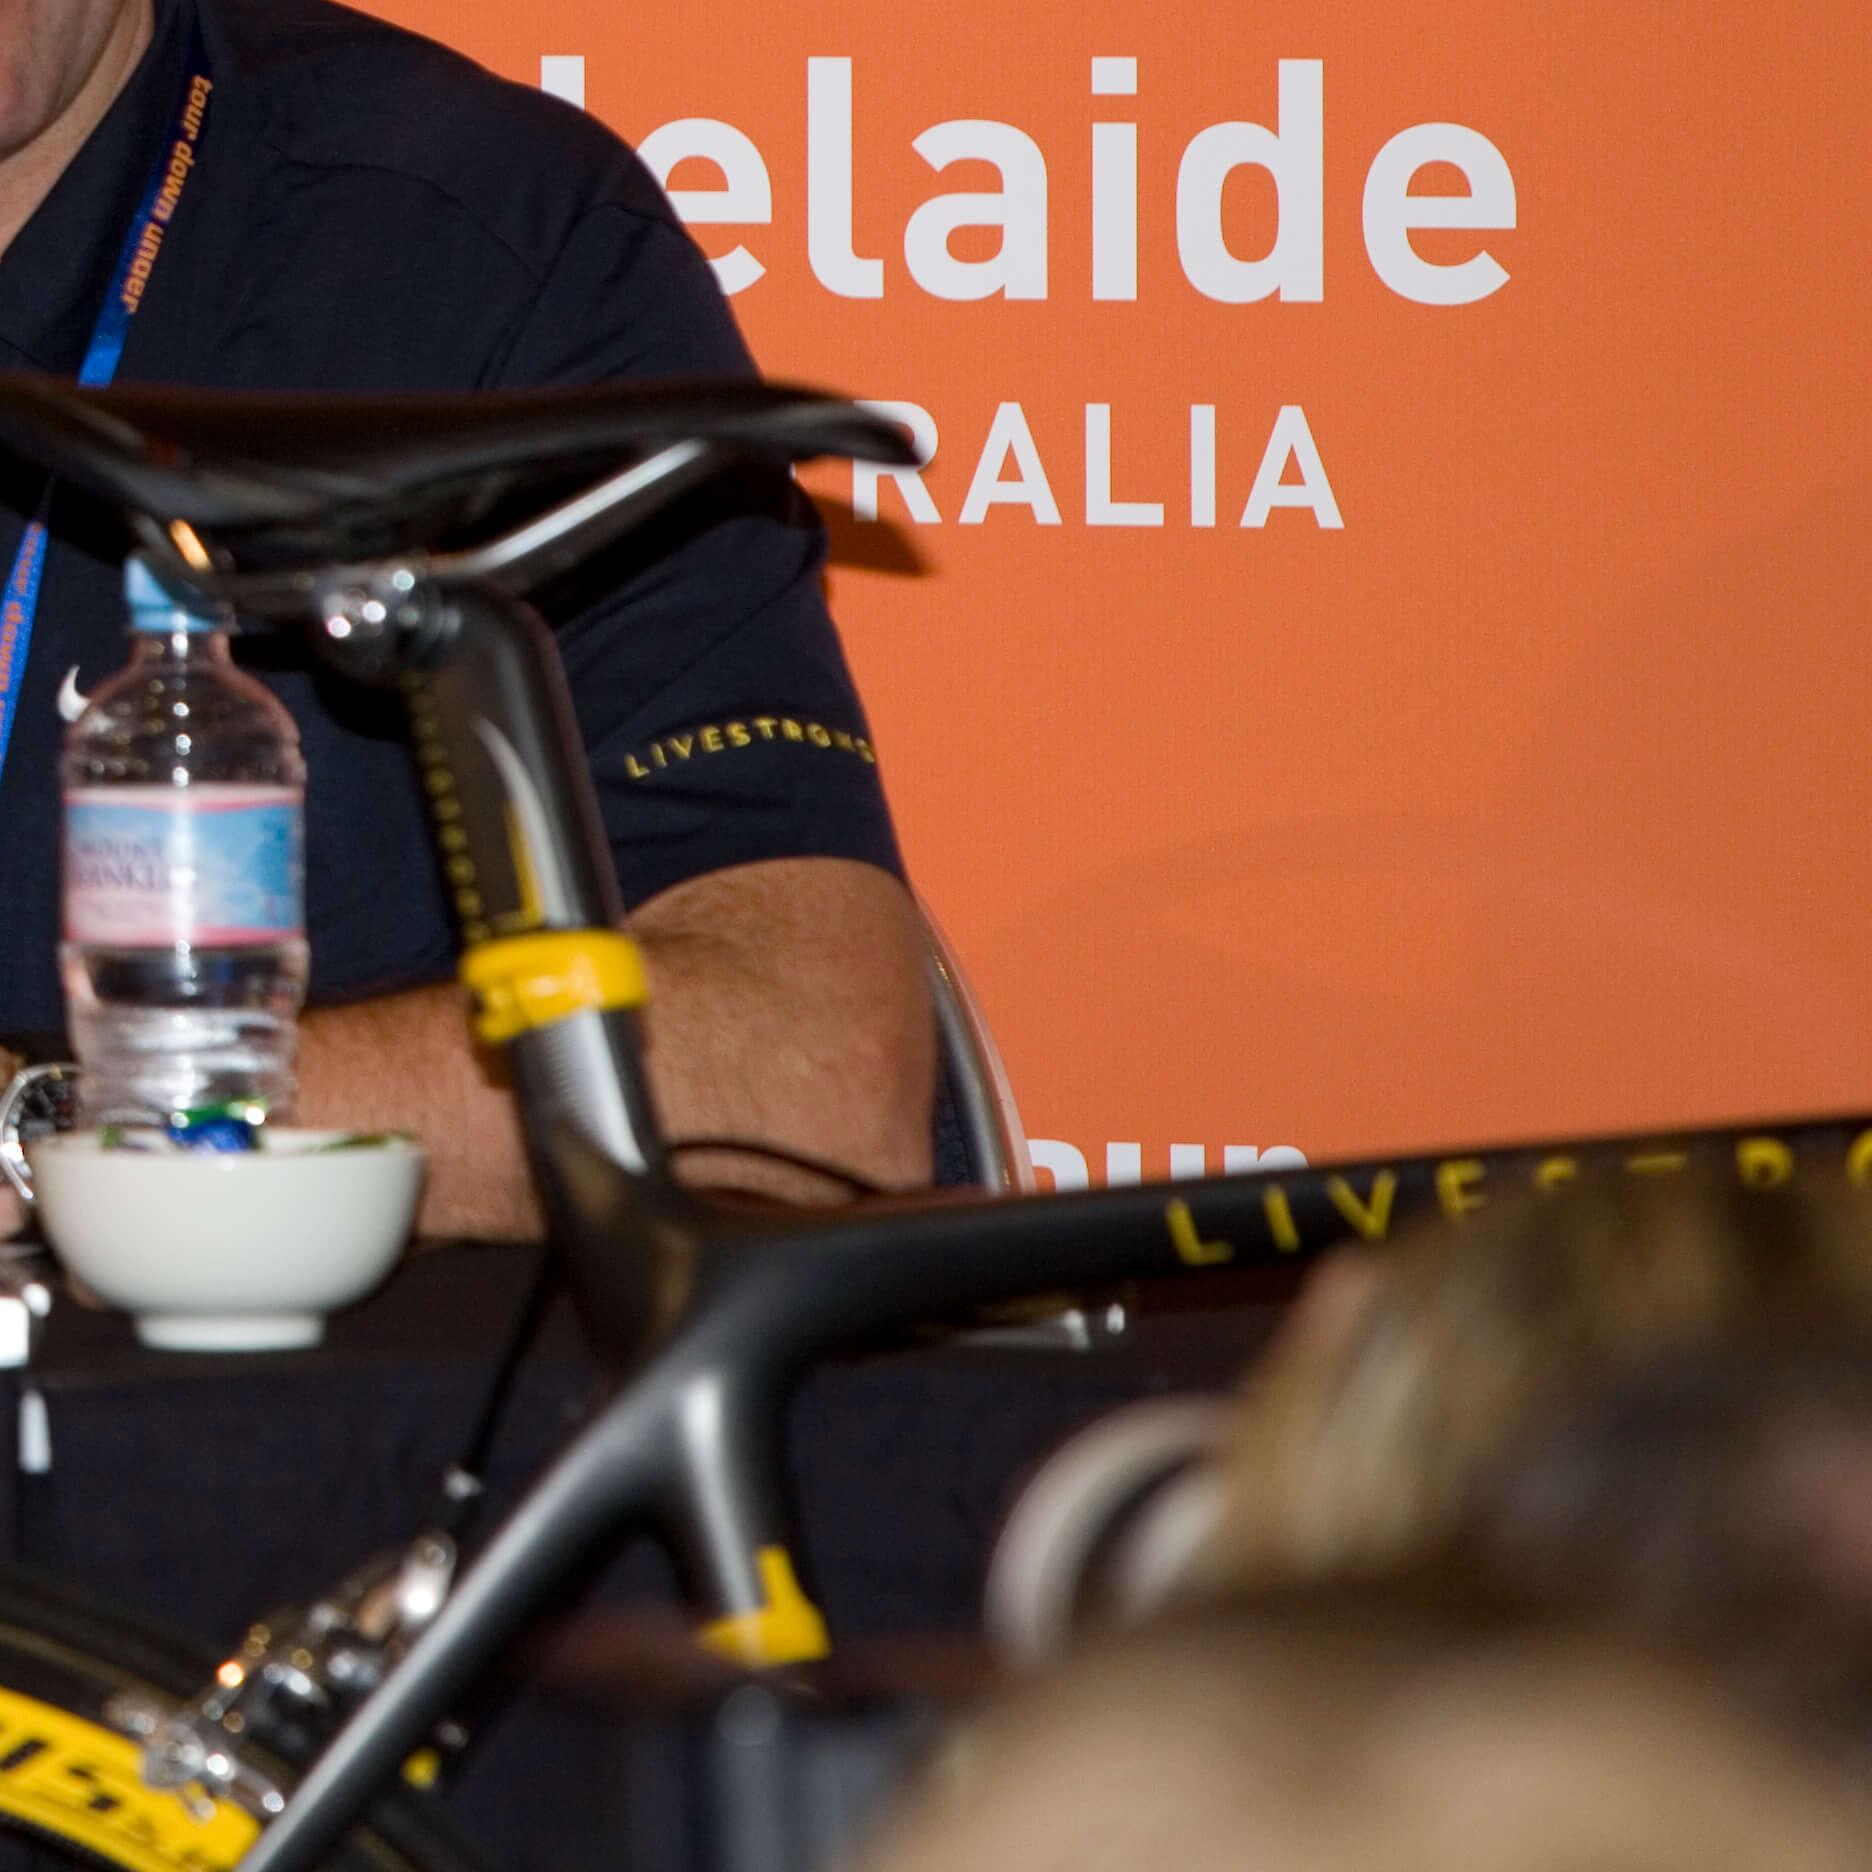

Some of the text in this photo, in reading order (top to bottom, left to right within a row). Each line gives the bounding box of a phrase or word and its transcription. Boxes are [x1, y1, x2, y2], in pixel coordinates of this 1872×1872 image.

[120, 74, 213, 314] tour down under
[541, 55, 1517, 306] elaide
